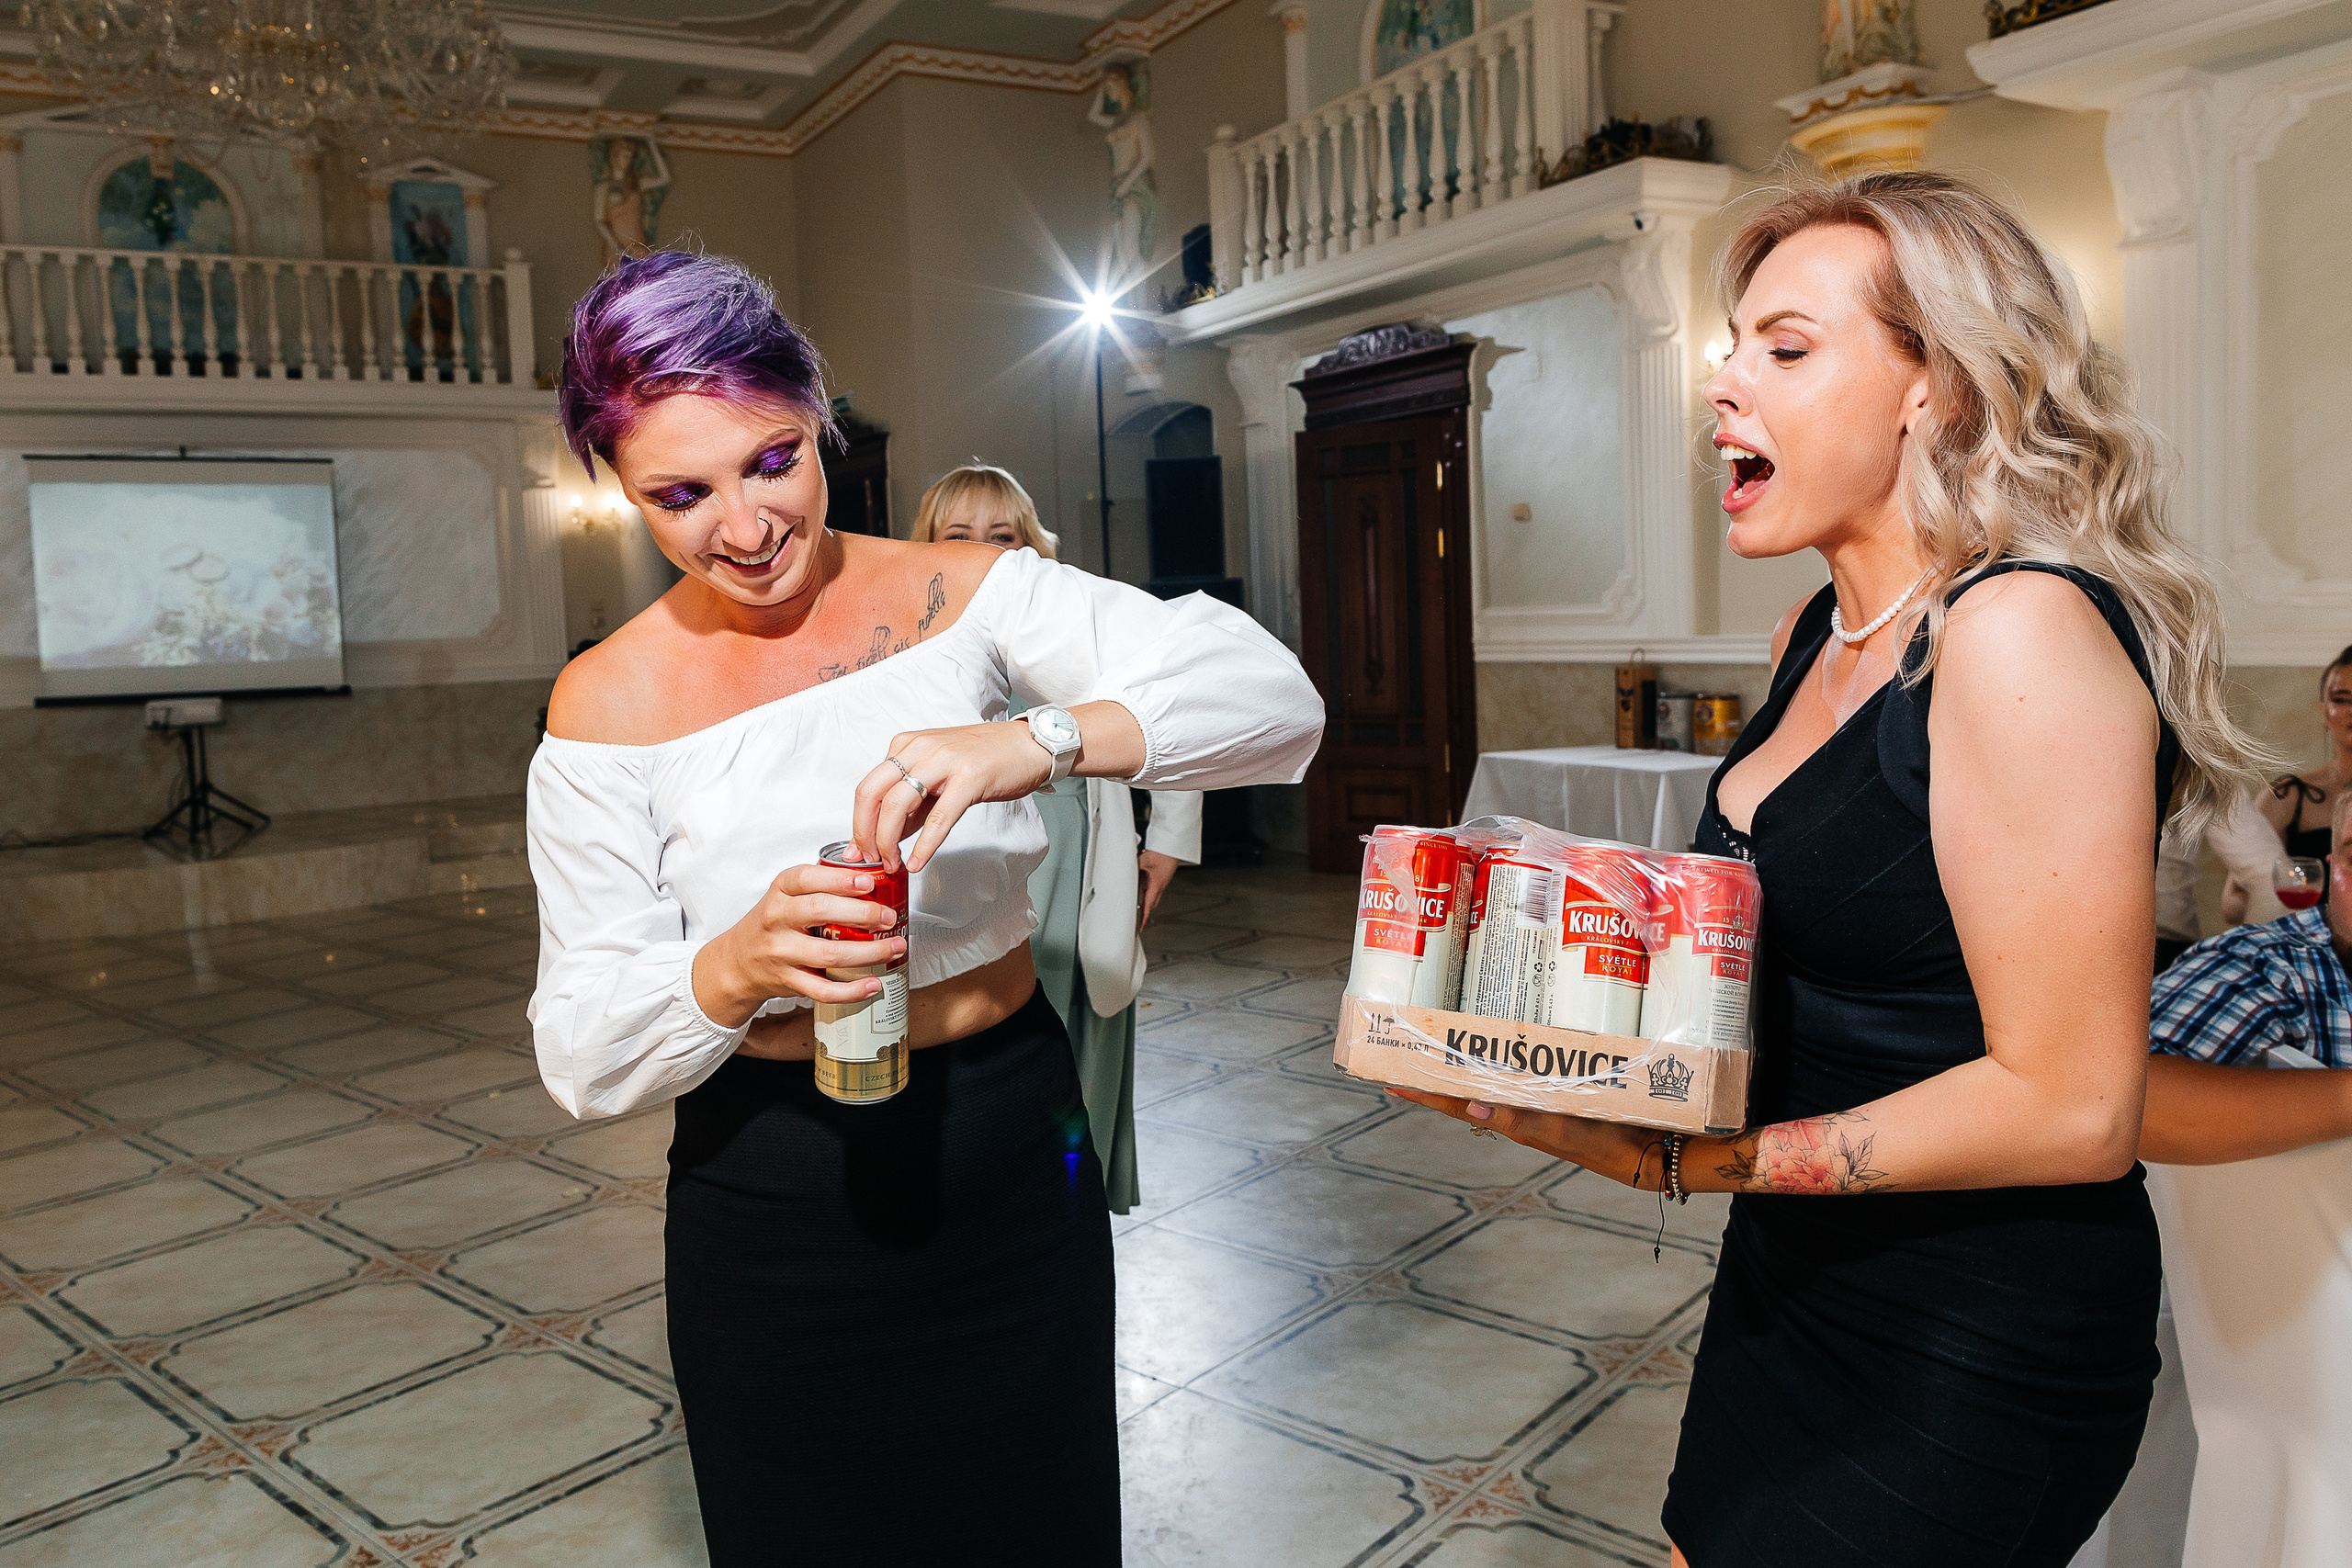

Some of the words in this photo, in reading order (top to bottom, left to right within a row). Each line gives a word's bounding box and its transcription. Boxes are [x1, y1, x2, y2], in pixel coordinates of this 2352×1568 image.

[1698, 929, 1756, 953] KRUŠOVIC
[1601, 964, 1634, 976] ROYAL
[1367, 1035, 1375, 1044] 24
[1376, 1037, 1400, 1048] БАНКИ
[1444, 1027, 1629, 1089] KRUŠOVICE
[865, 1073, 890, 1082] CZECH
